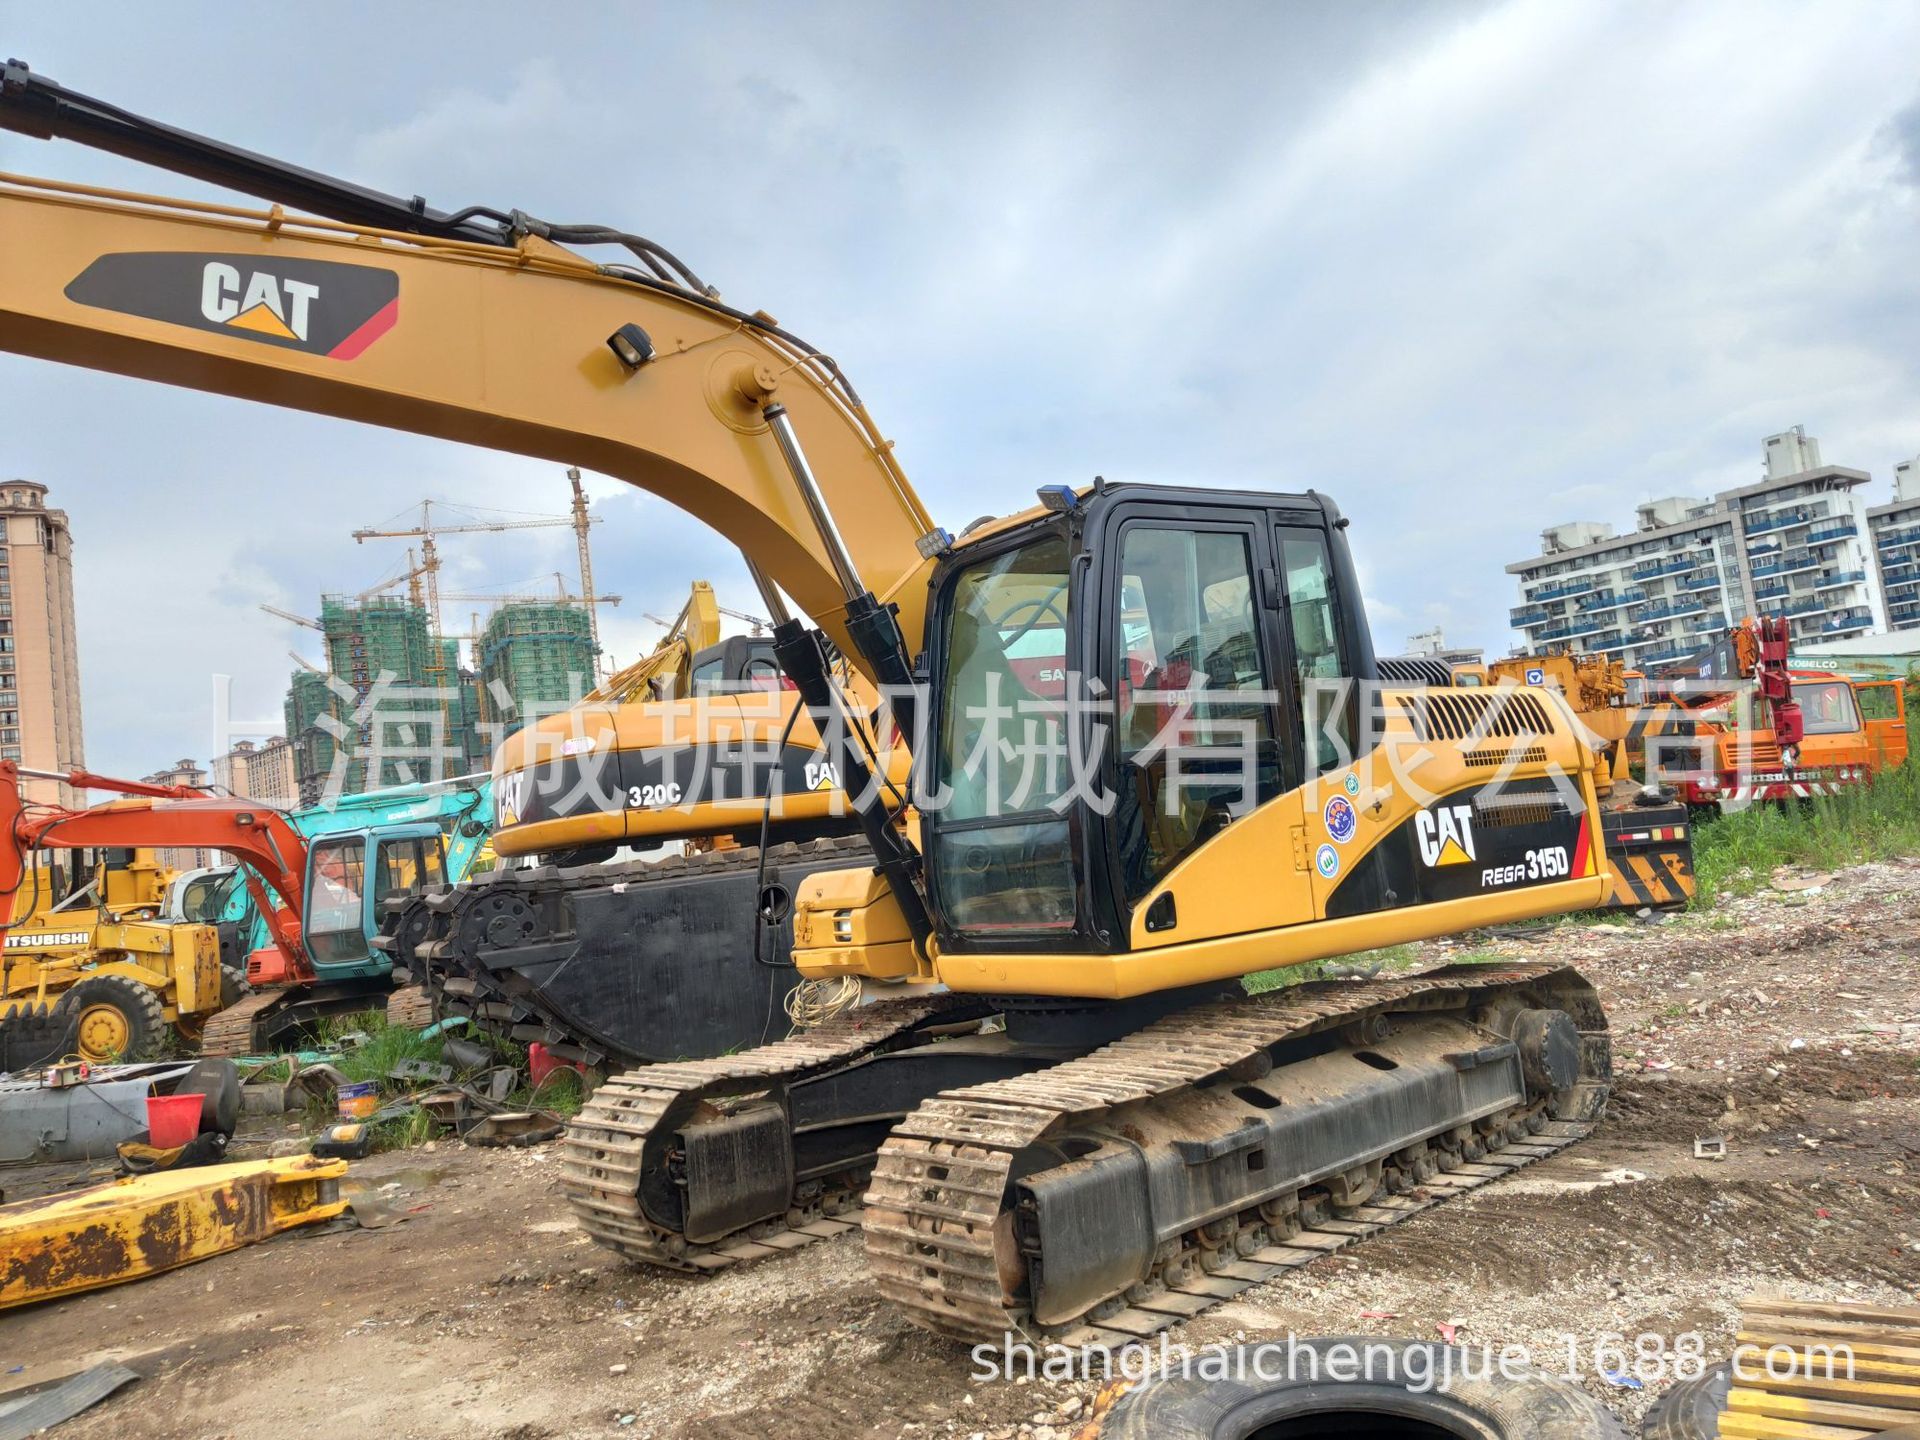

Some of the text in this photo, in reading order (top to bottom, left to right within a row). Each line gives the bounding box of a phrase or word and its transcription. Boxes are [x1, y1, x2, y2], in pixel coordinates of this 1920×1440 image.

[201, 261, 319, 342] CAT
[1039, 668, 1065, 682] SA
[499, 772, 524, 828] CAT
[629, 782, 681, 807] 320C
[1415, 805, 1477, 868] CAT
[1481, 846, 1569, 887] REGA 315D
[4, 932, 90, 948] ITSUBISHI
